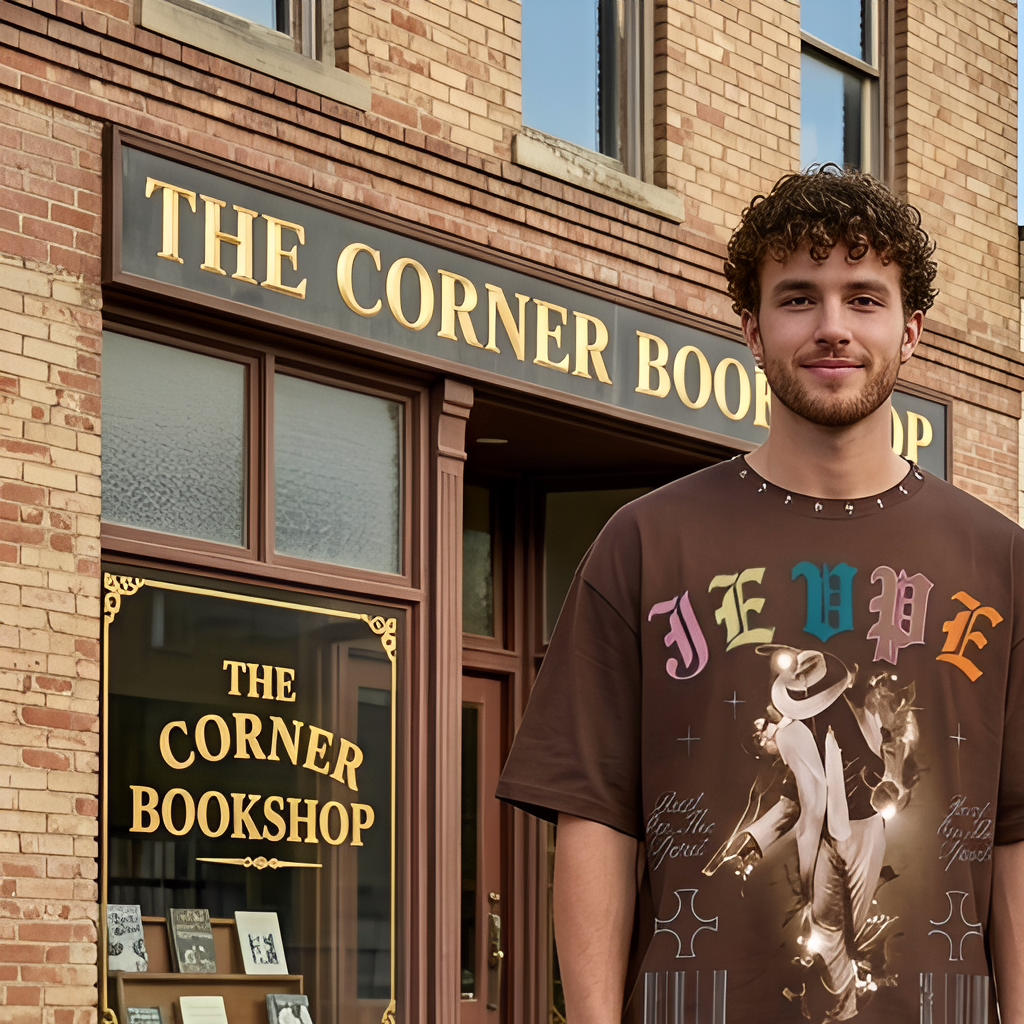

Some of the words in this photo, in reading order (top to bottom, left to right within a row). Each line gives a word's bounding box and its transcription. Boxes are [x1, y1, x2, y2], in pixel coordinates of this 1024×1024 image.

[145, 176, 307, 299] THE
[336, 242, 613, 385] CORNER
[223, 660, 297, 702] THE
[159, 713, 364, 791] CORNER
[129, 785, 375, 847] BOOKSHOP
